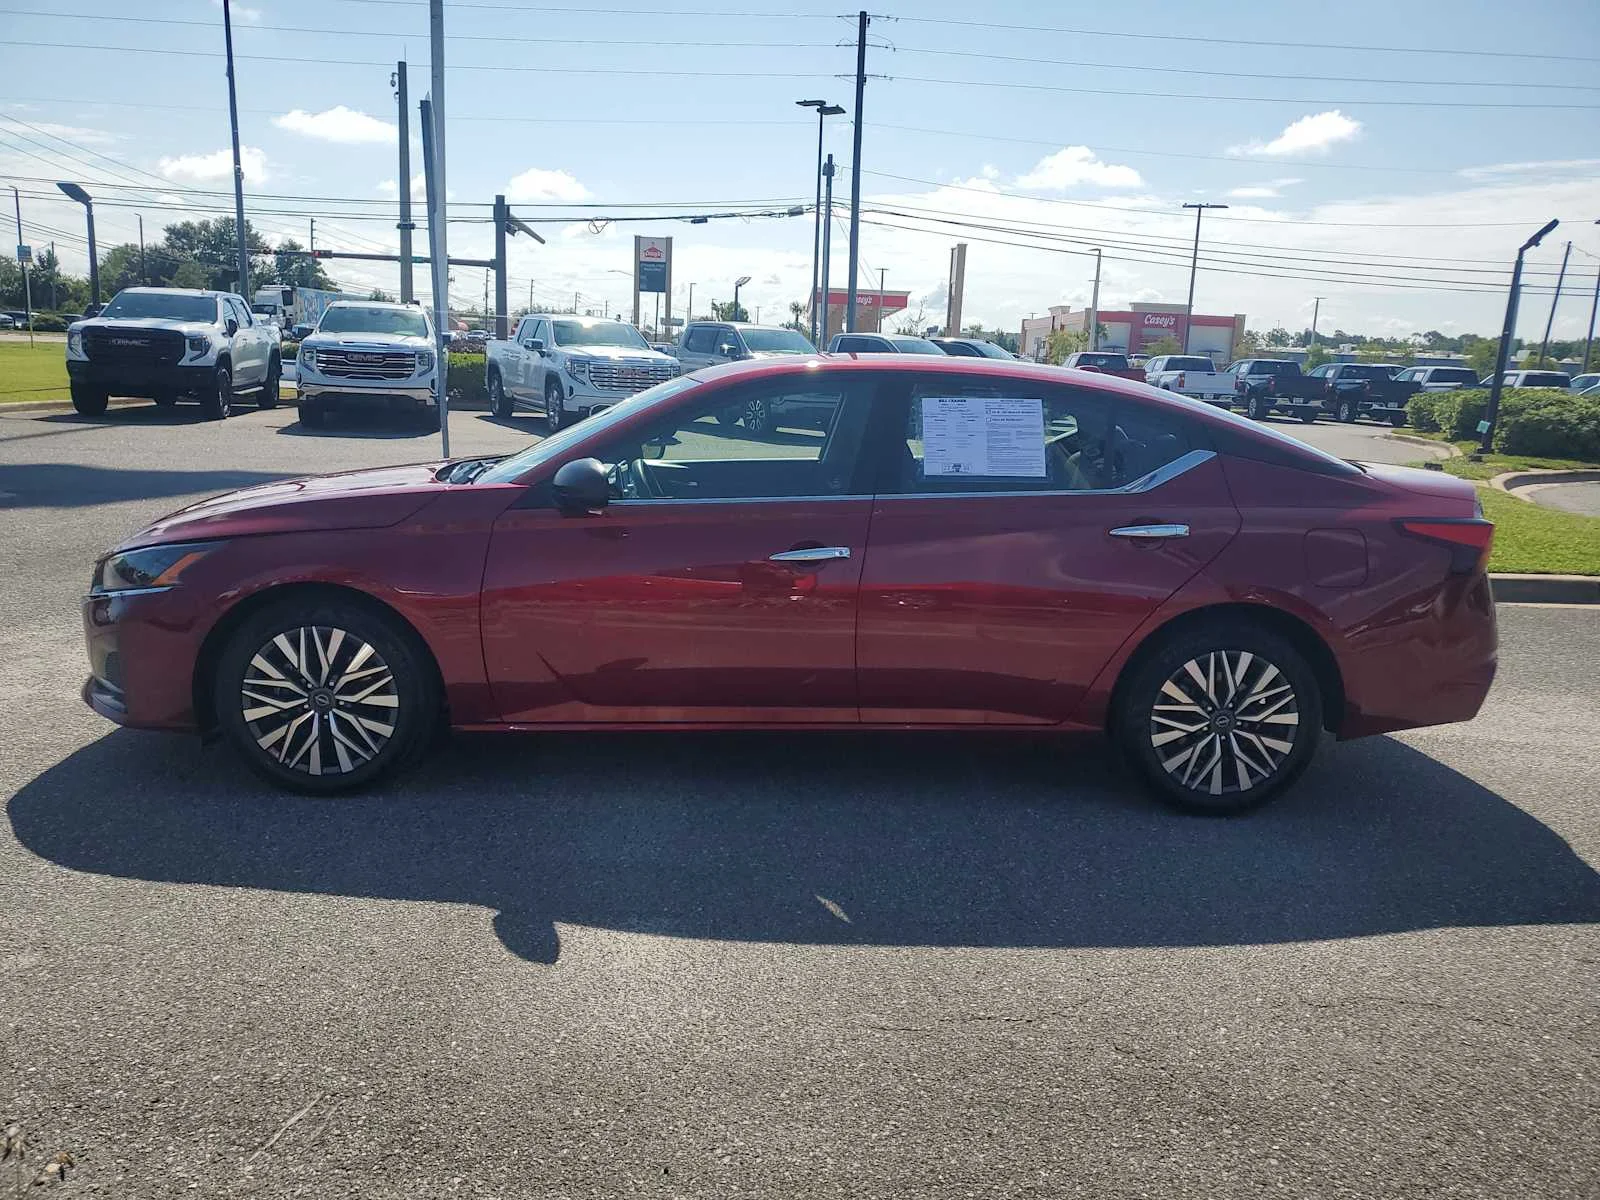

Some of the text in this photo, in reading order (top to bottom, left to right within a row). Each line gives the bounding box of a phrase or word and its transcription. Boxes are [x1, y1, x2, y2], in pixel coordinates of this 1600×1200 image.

[1144, 314, 1175, 327] Casey's
[347, 352, 383, 362] GMC
[617, 367, 649, 376] GMC
